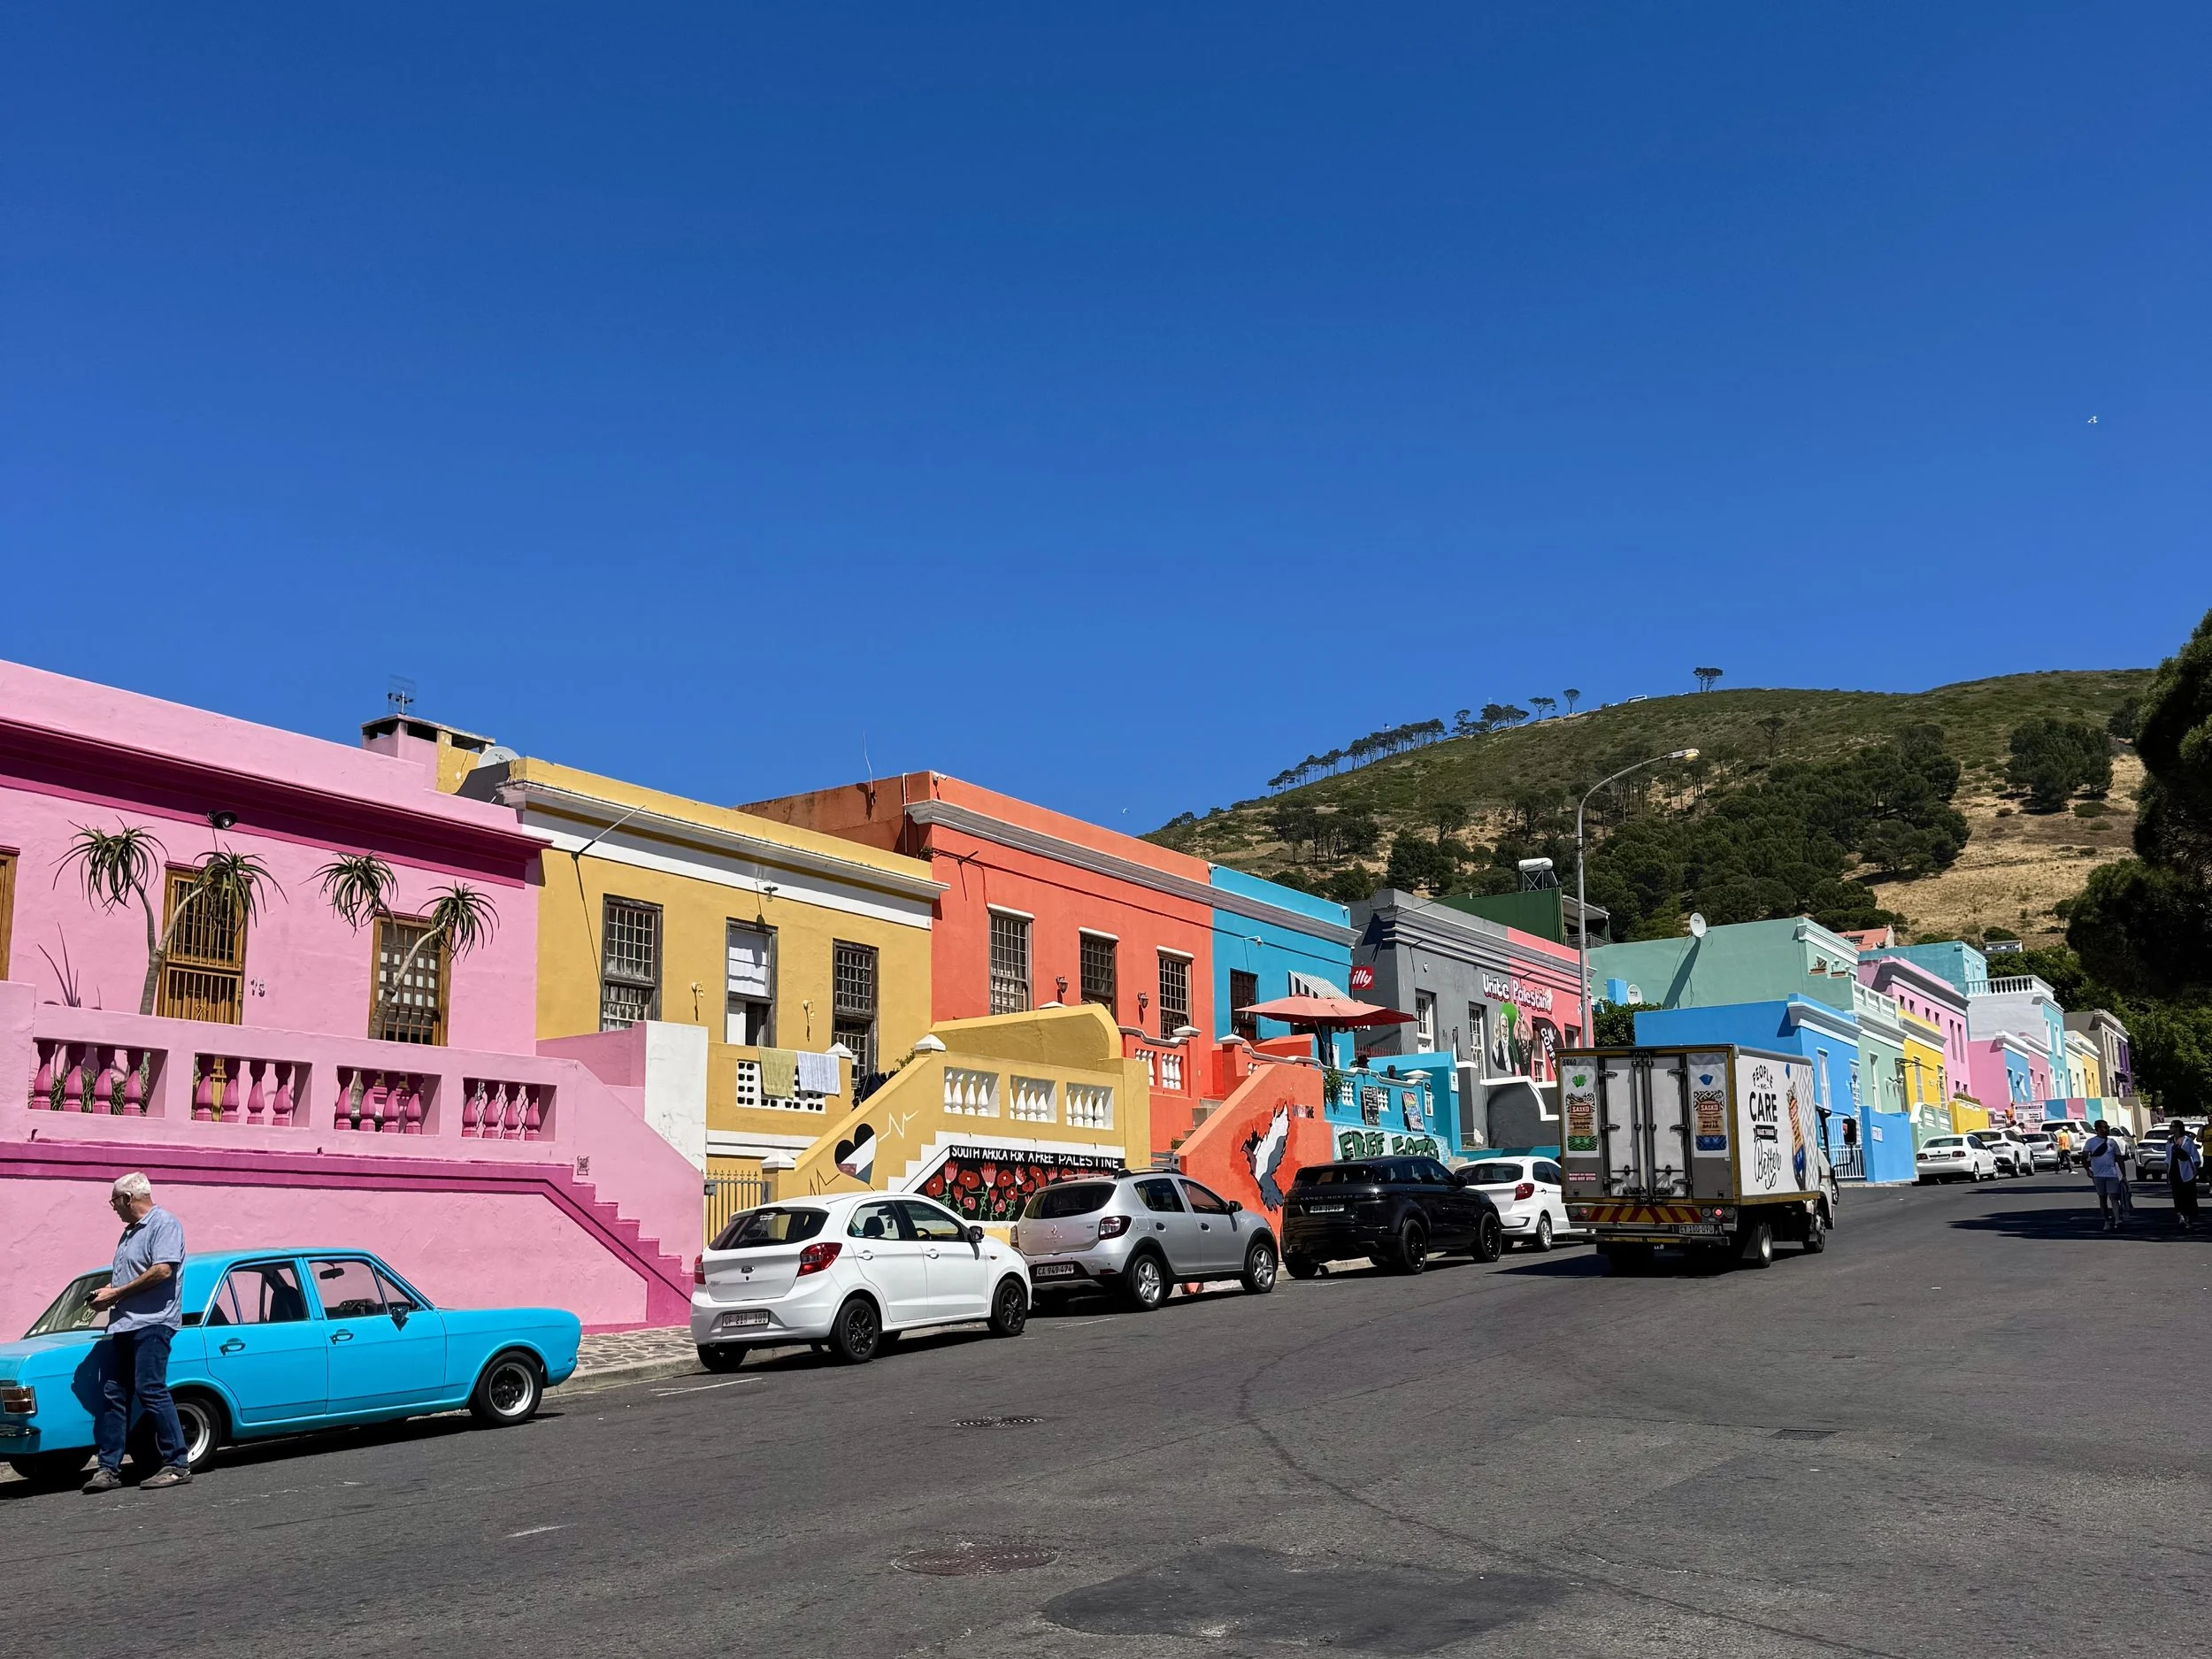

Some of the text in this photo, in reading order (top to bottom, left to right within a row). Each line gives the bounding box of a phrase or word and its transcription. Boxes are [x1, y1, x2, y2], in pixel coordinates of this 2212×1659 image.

[1352, 970, 1371, 987] illy
[1483, 972, 1509, 1001] Unite
[1752, 1064, 1773, 1088] PEOPLE
[1749, 1091, 1778, 1123] CARE
[951, 1147, 1119, 1168] SOUTH AFRICA FOR A FREE PALESTINE
